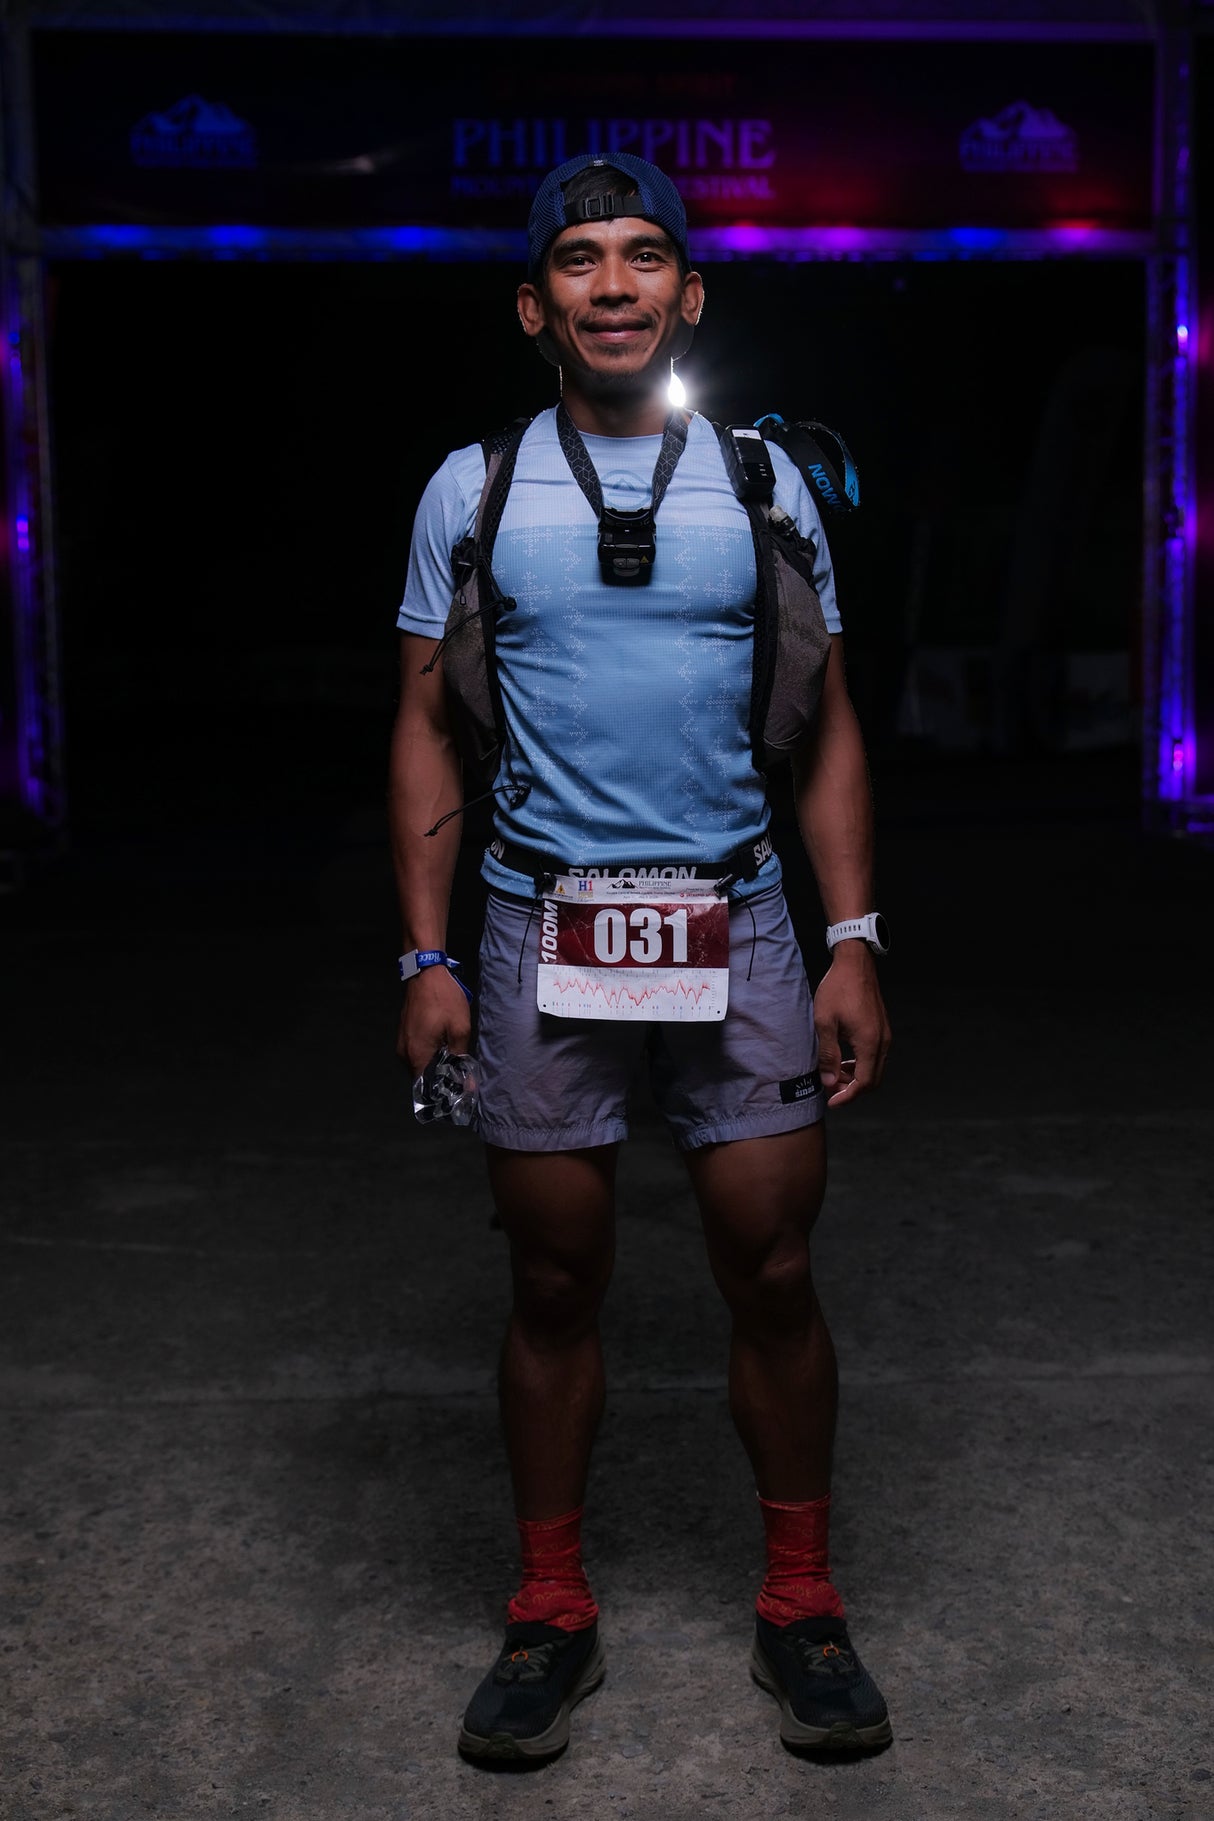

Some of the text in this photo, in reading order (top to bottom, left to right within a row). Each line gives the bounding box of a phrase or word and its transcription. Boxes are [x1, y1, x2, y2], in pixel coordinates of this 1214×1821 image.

[451, 118, 775, 168] PHILIPPINE
[578, 880, 593, 892] H1
[541, 900, 559, 963] 100M
[593, 907, 688, 964] 031
